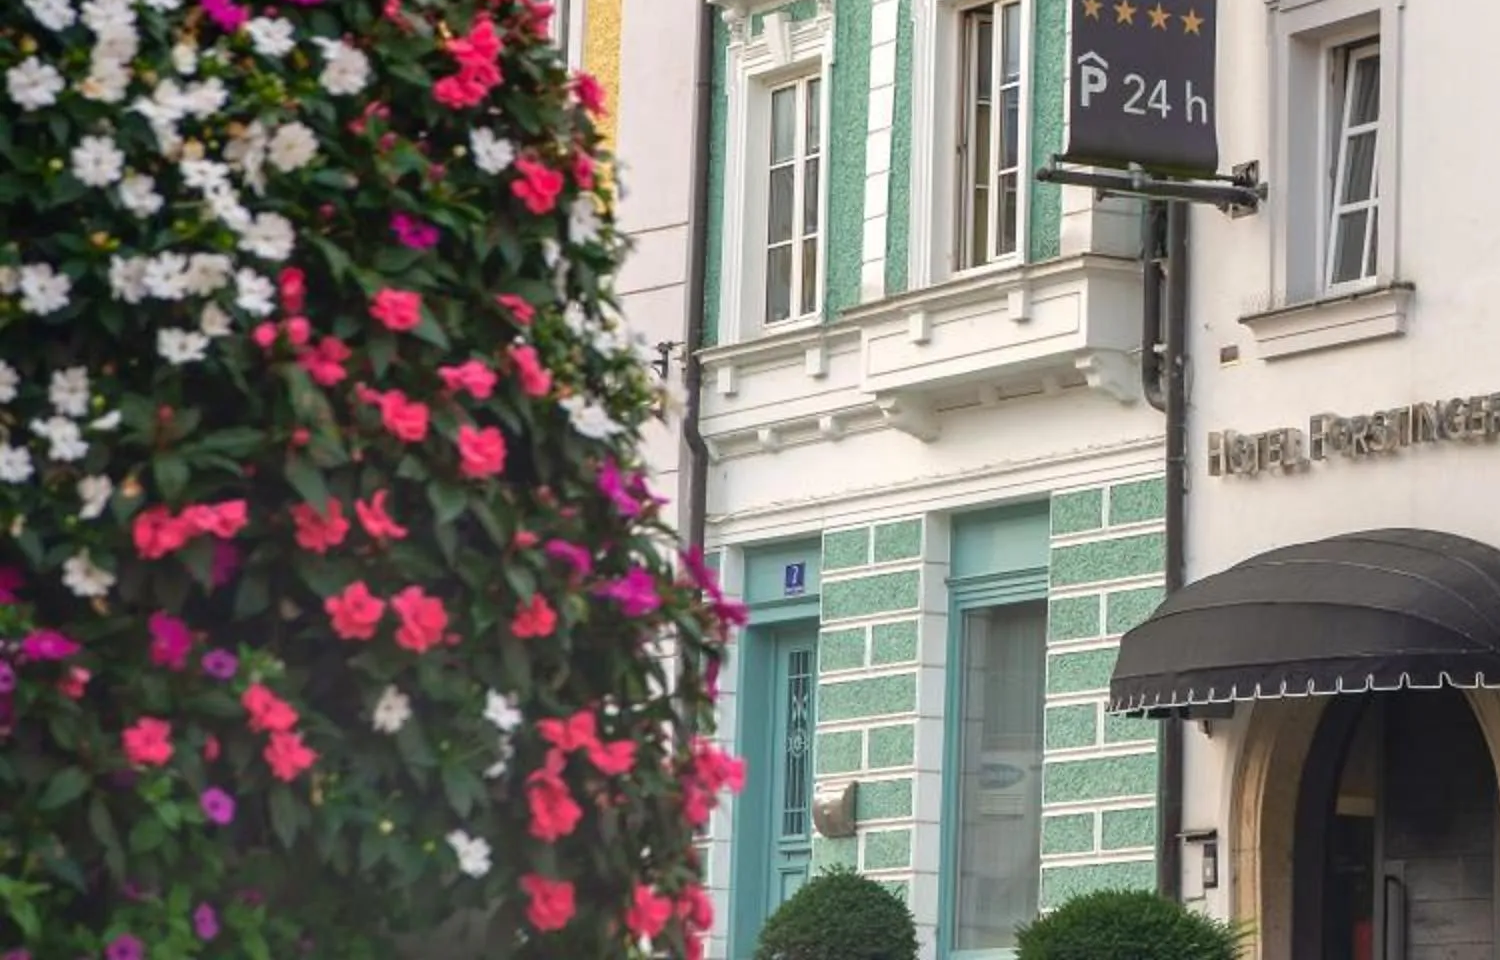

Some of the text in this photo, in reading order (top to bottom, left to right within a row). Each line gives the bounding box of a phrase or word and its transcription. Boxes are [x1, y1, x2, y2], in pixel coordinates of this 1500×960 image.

[1080, 62, 1208, 124] P 24 h
[1207, 428, 1309, 477] HOTEL
